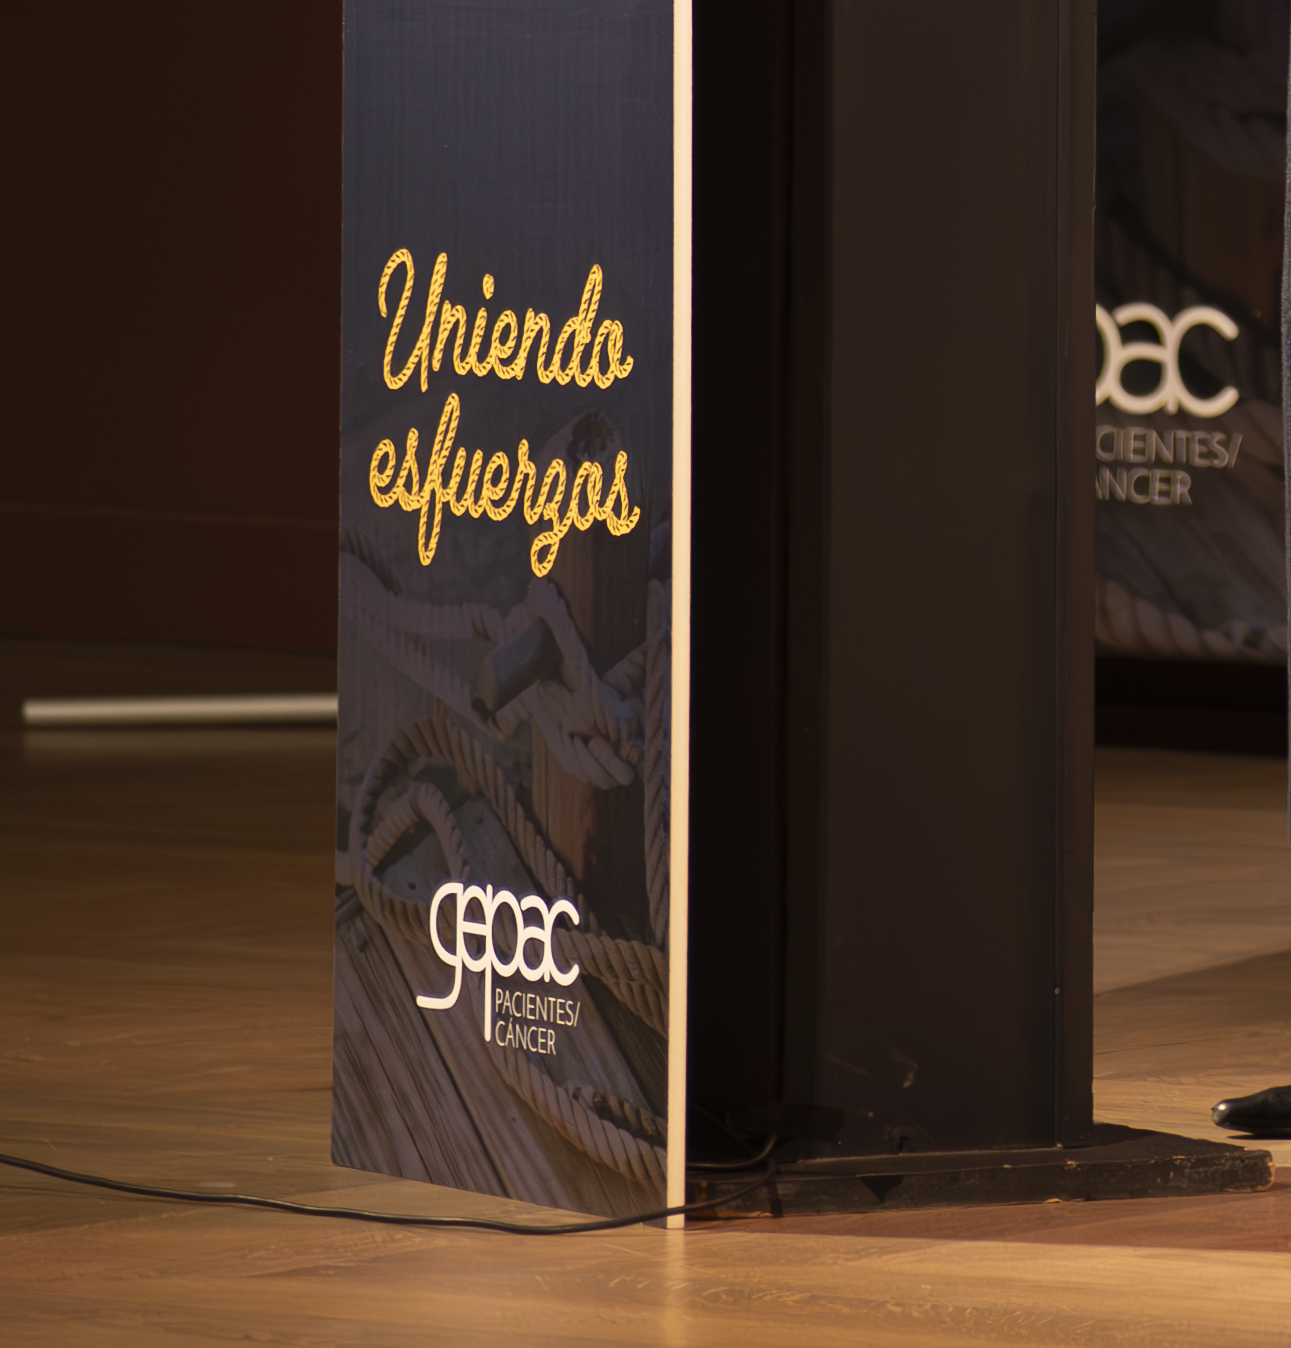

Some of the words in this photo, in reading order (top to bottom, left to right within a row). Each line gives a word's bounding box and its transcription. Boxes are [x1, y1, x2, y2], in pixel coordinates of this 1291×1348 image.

[377, 247, 634, 393] Uniendo
[1095, 424, 1244, 468] CIENTES/
[368, 391, 640, 579] esfuerzos
[1095, 467, 1193, 505] NCER
[416, 881, 581, 1043] gepac
[494, 987, 581, 1027] PACIENTES/
[495, 1019, 558, 1056] CÁNCER
